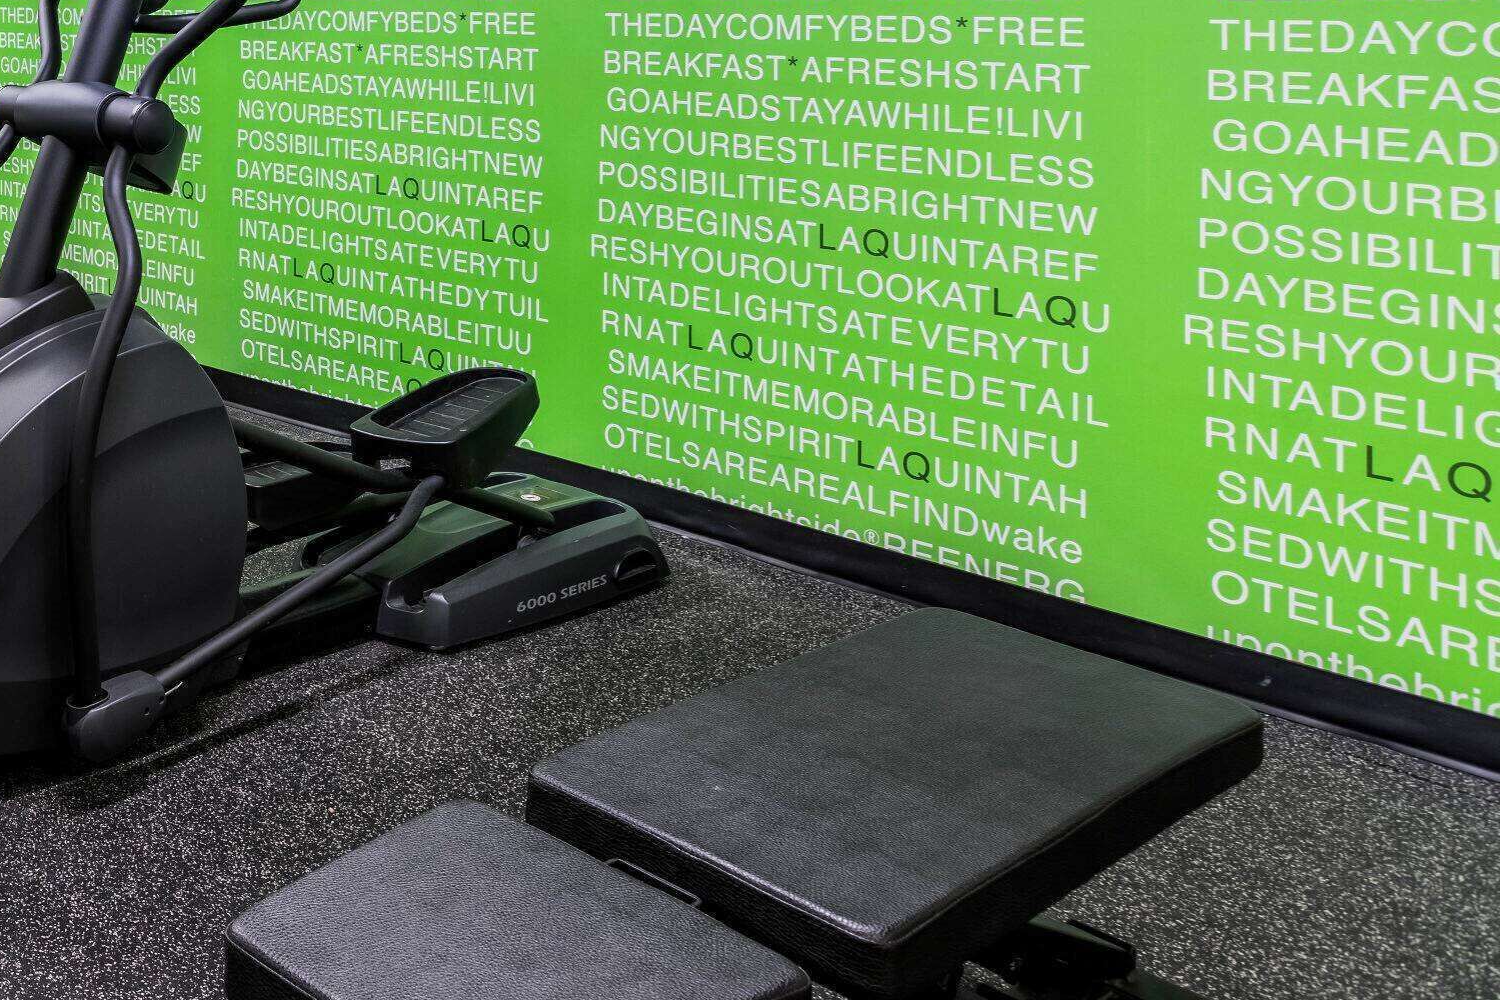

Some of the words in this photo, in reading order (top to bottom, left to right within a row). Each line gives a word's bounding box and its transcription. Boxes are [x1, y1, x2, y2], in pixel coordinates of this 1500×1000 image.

[239, 99, 541, 144] NGYOURBESTLIFEENDLESS
[243, 70, 534, 106] GOAHEADSTAYAWHILE!LIVI
[607, 87, 1083, 140] GOAHEADSTAYAWHILE!LIVI
[236, 129, 545, 178] POSSIBILITIESABRIGHTNEW
[600, 124, 1094, 188] NGYOURBESTLIFEENDLESS
[1212, 119, 1500, 167] GOAHEAD
[231, 187, 550, 252] RESHYOUROUTLOOKATLAQU
[236, 159, 543, 213] DAYBEGINSATLAQUINTAREF
[598, 161, 1098, 236] POSSIBILITIESABRIGHTNEW
[240, 218, 538, 285] INTADELIGHTSATEVERYTU
[598, 197, 1098, 281] DAYBEGINSATLAQUINTAREF
[590, 234, 1110, 334] RESHYOUROUTLOOKATLAQU
[1197, 267, 1500, 334] DAYBEGIN
[603, 272, 1090, 375] INTADELIGHTSATEVERYTU
[1184, 313, 1500, 391] RESHYOUR
[601, 309, 1108, 427] RNATLAQUINTATHEDETAIL
[608, 348, 1078, 469] SMAKEITMEMORABLEINFU
[602, 384, 1087, 519] SEDWITHSPIRITLAQUINTAH
[1204, 416, 1492, 503] RNATLAQ
[604, 423, 1083, 564] OTELSAREAREALFINDwake
[516, 592, 557, 612] 6000
[560, 574, 607, 599] SERIES
